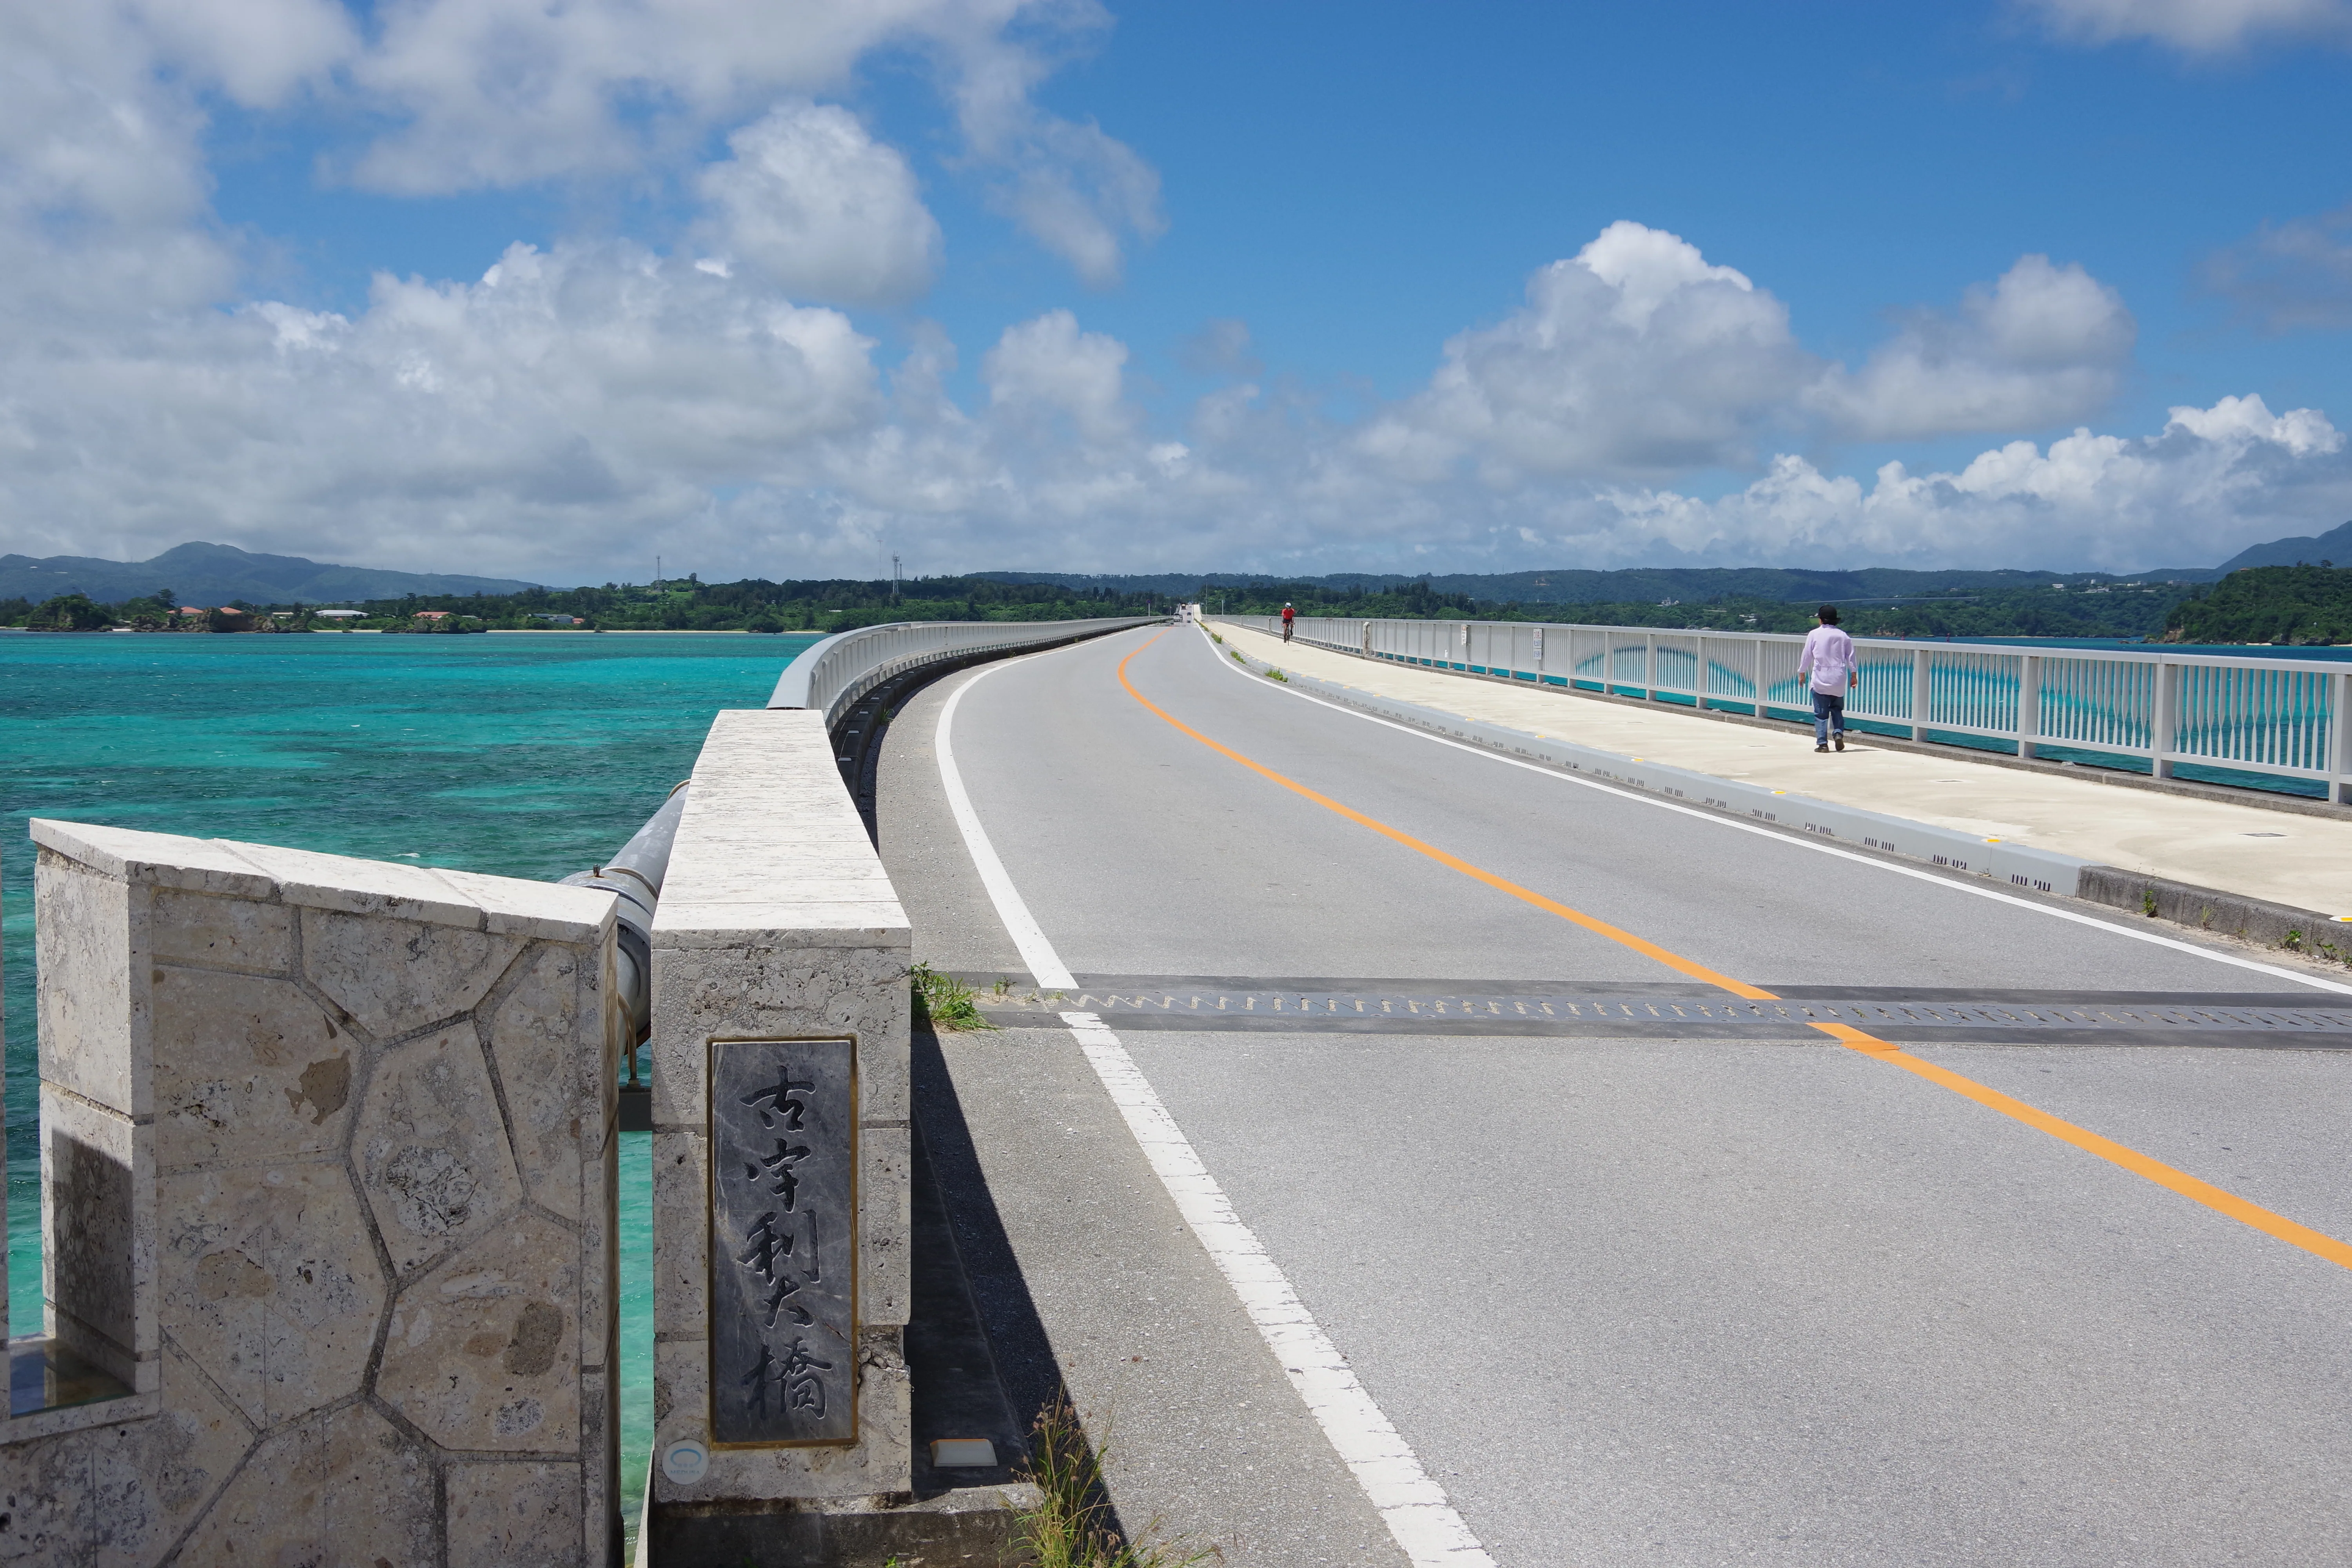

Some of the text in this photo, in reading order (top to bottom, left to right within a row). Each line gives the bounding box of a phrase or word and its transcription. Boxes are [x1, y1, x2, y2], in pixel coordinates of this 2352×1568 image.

[737, 1065, 833, 1420] 古宇利大橋
